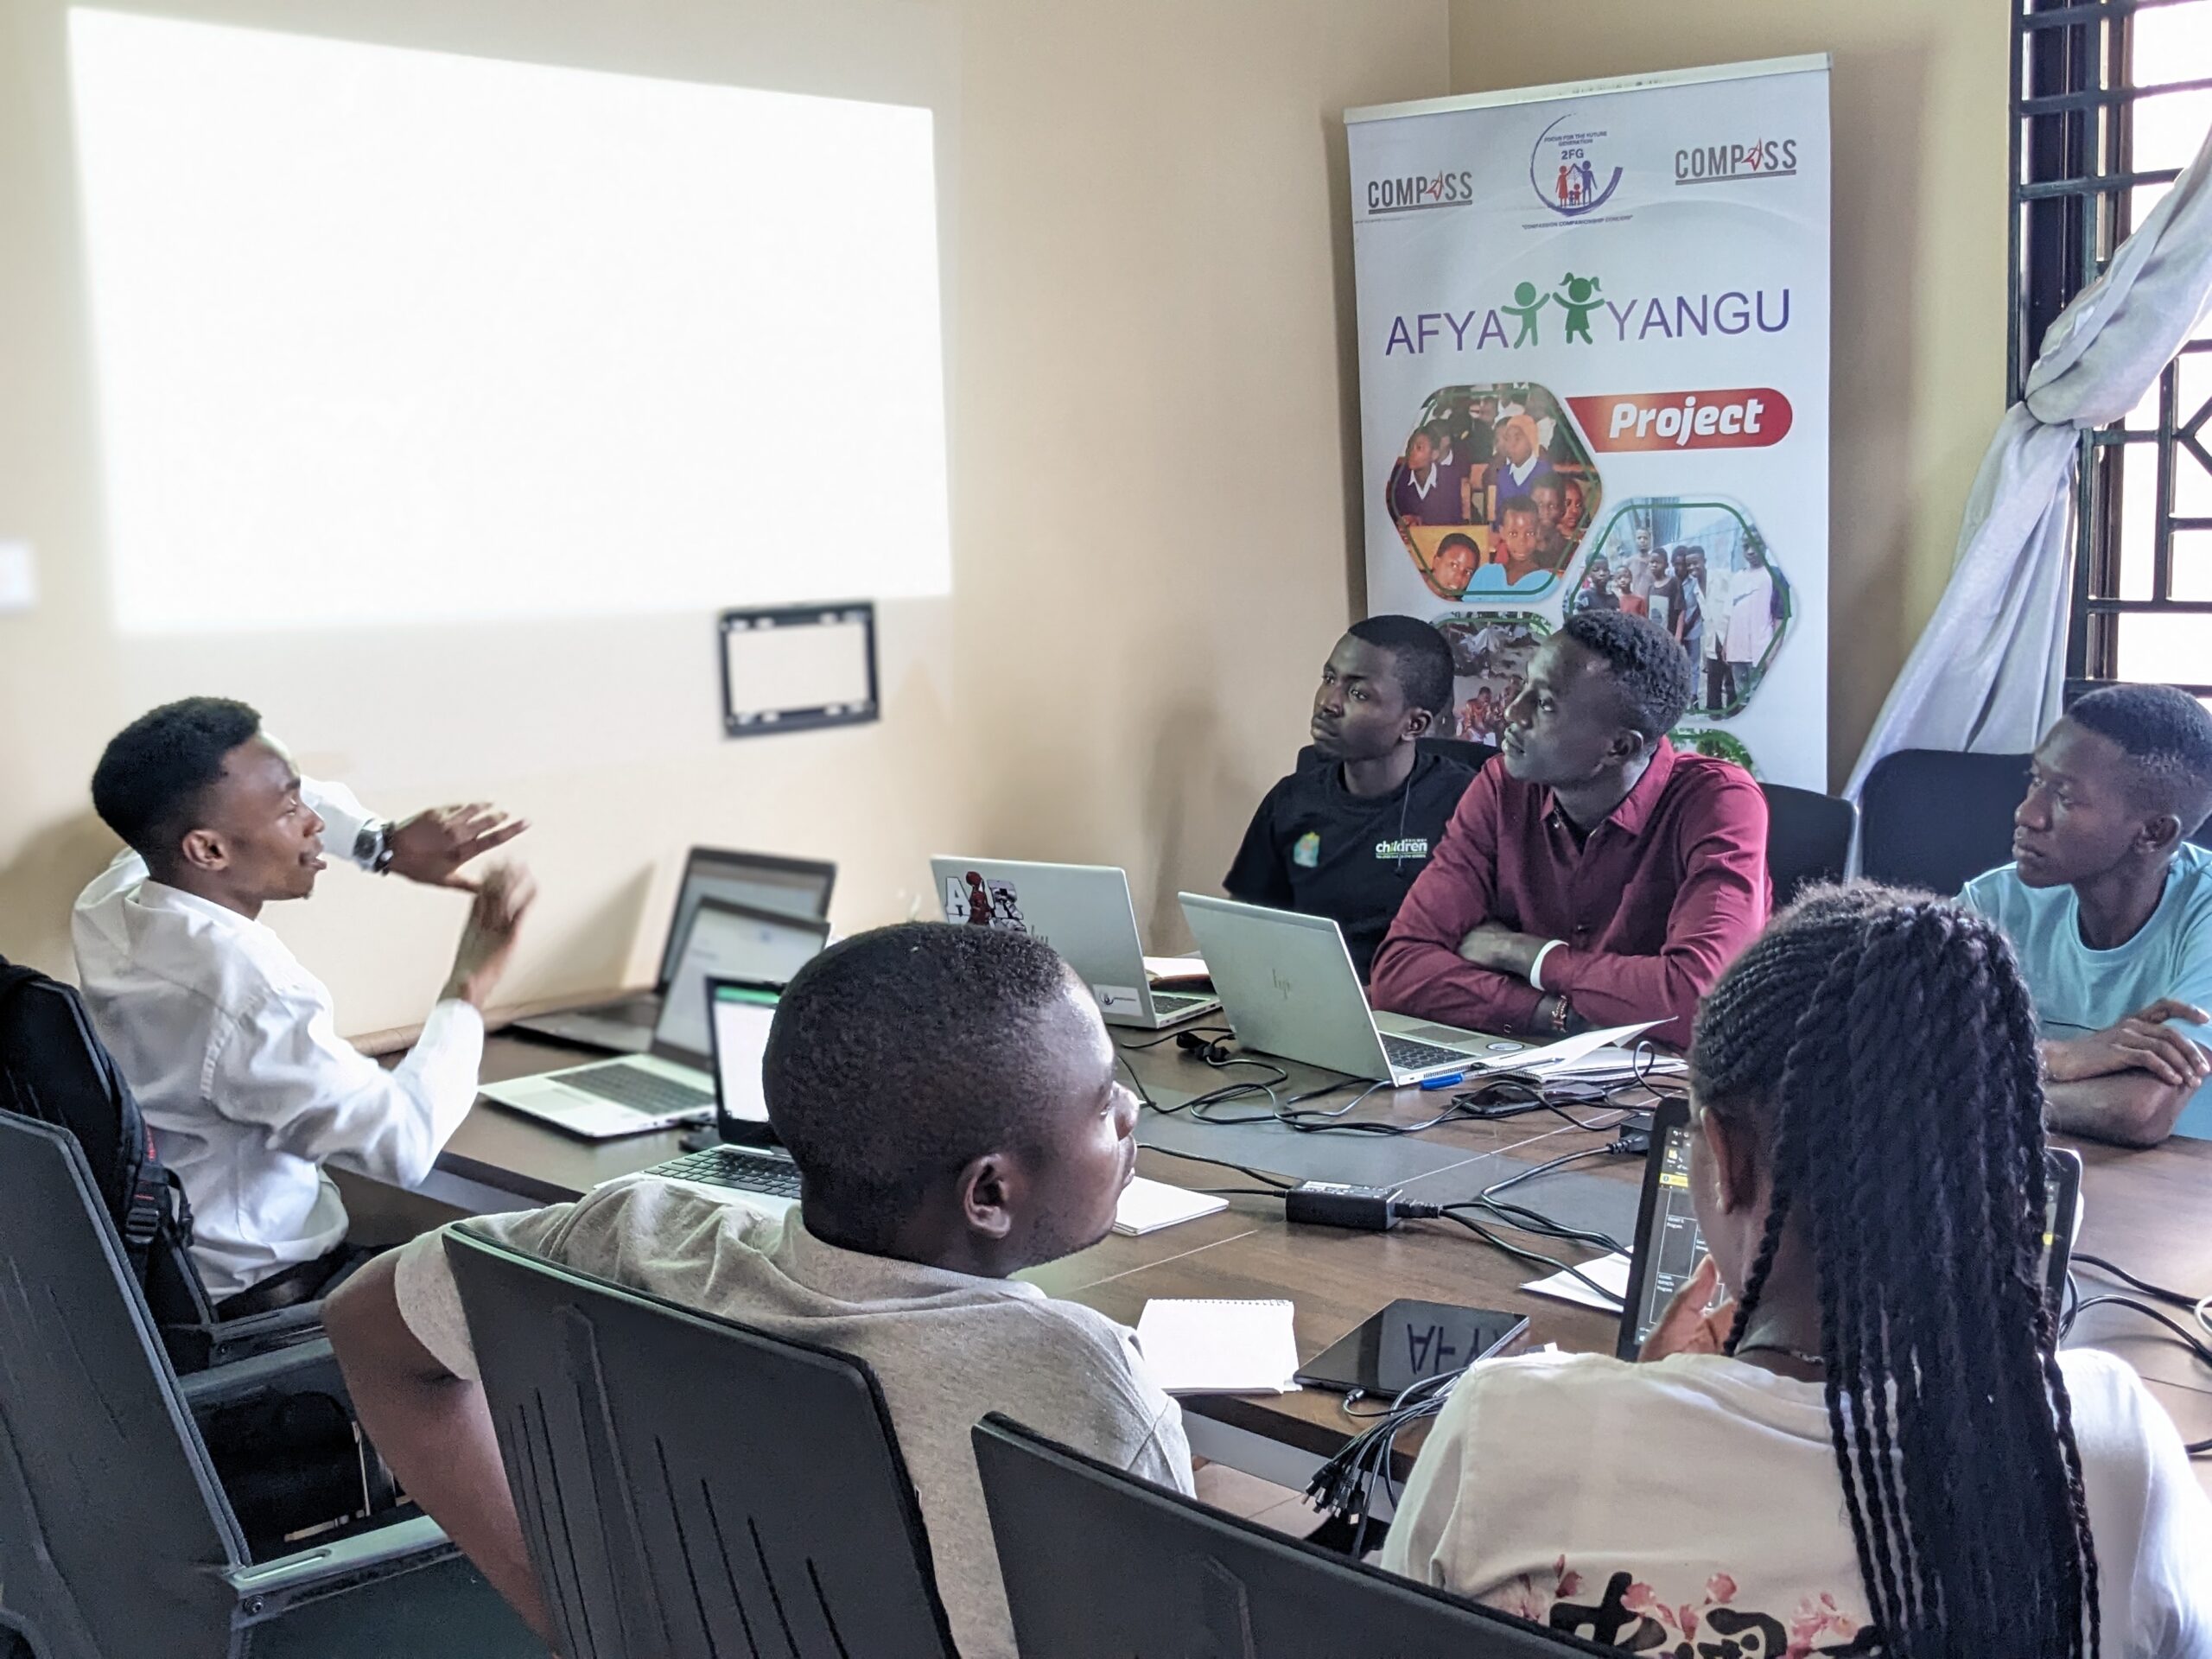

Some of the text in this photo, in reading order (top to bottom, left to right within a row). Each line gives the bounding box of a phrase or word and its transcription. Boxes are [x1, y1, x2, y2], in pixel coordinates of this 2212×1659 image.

[1561, 149, 1585, 160] 2FG
[1675, 137, 1797, 179] COMPASS
[1368, 170, 1472, 208] COMPASS
[1385, 308, 1510, 355] AFYA
[1605, 289, 1789, 342] YANGU
[1609, 396, 1764, 446] Project
[1376, 840, 1428, 853] children
